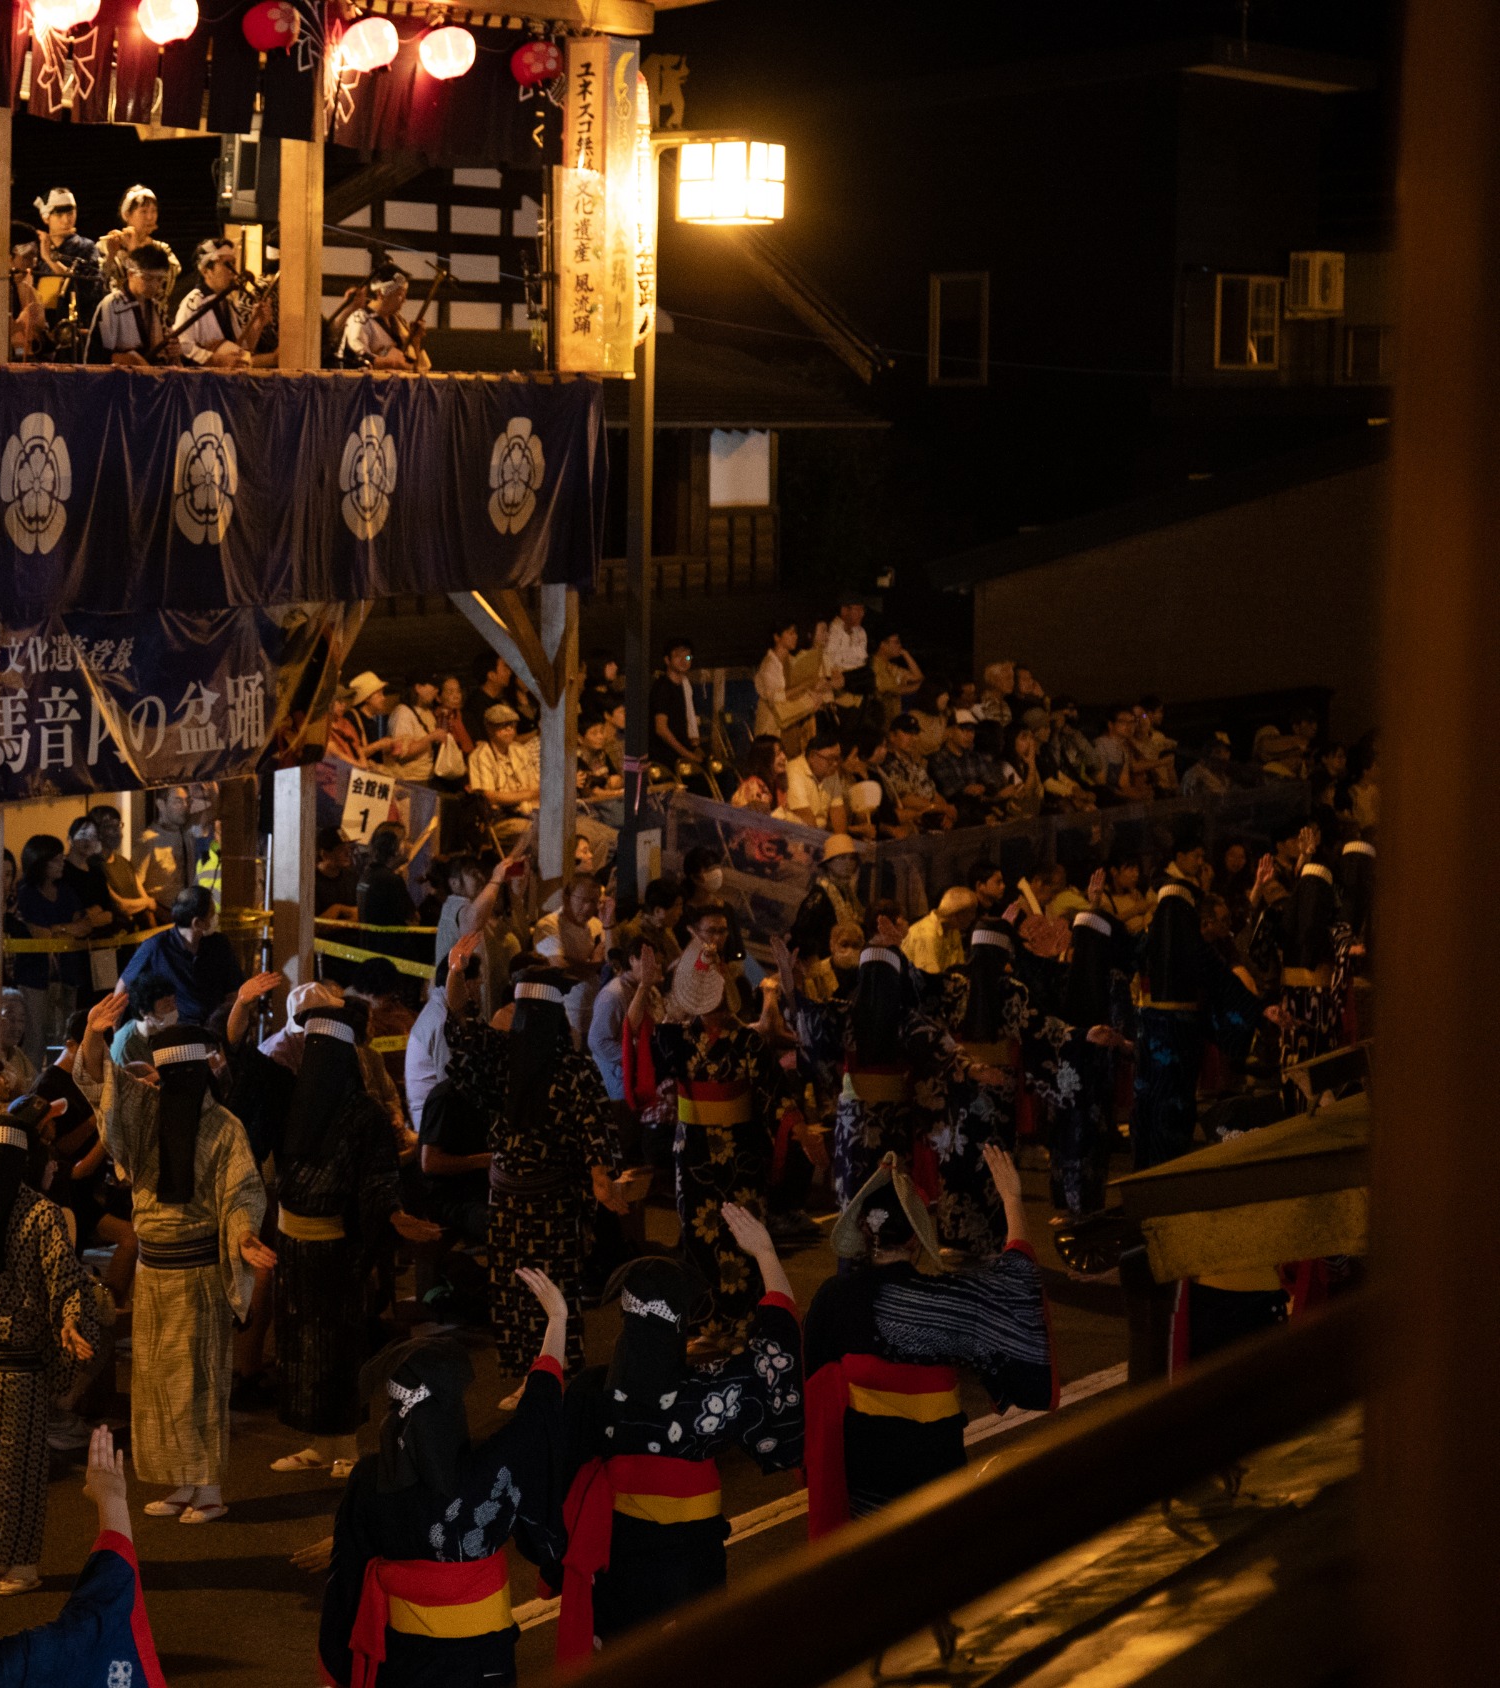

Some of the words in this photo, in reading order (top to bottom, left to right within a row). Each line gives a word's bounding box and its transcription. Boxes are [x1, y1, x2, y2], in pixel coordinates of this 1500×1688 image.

[352, 777, 390, 802] 会館横
[359, 808, 370, 833] 1
